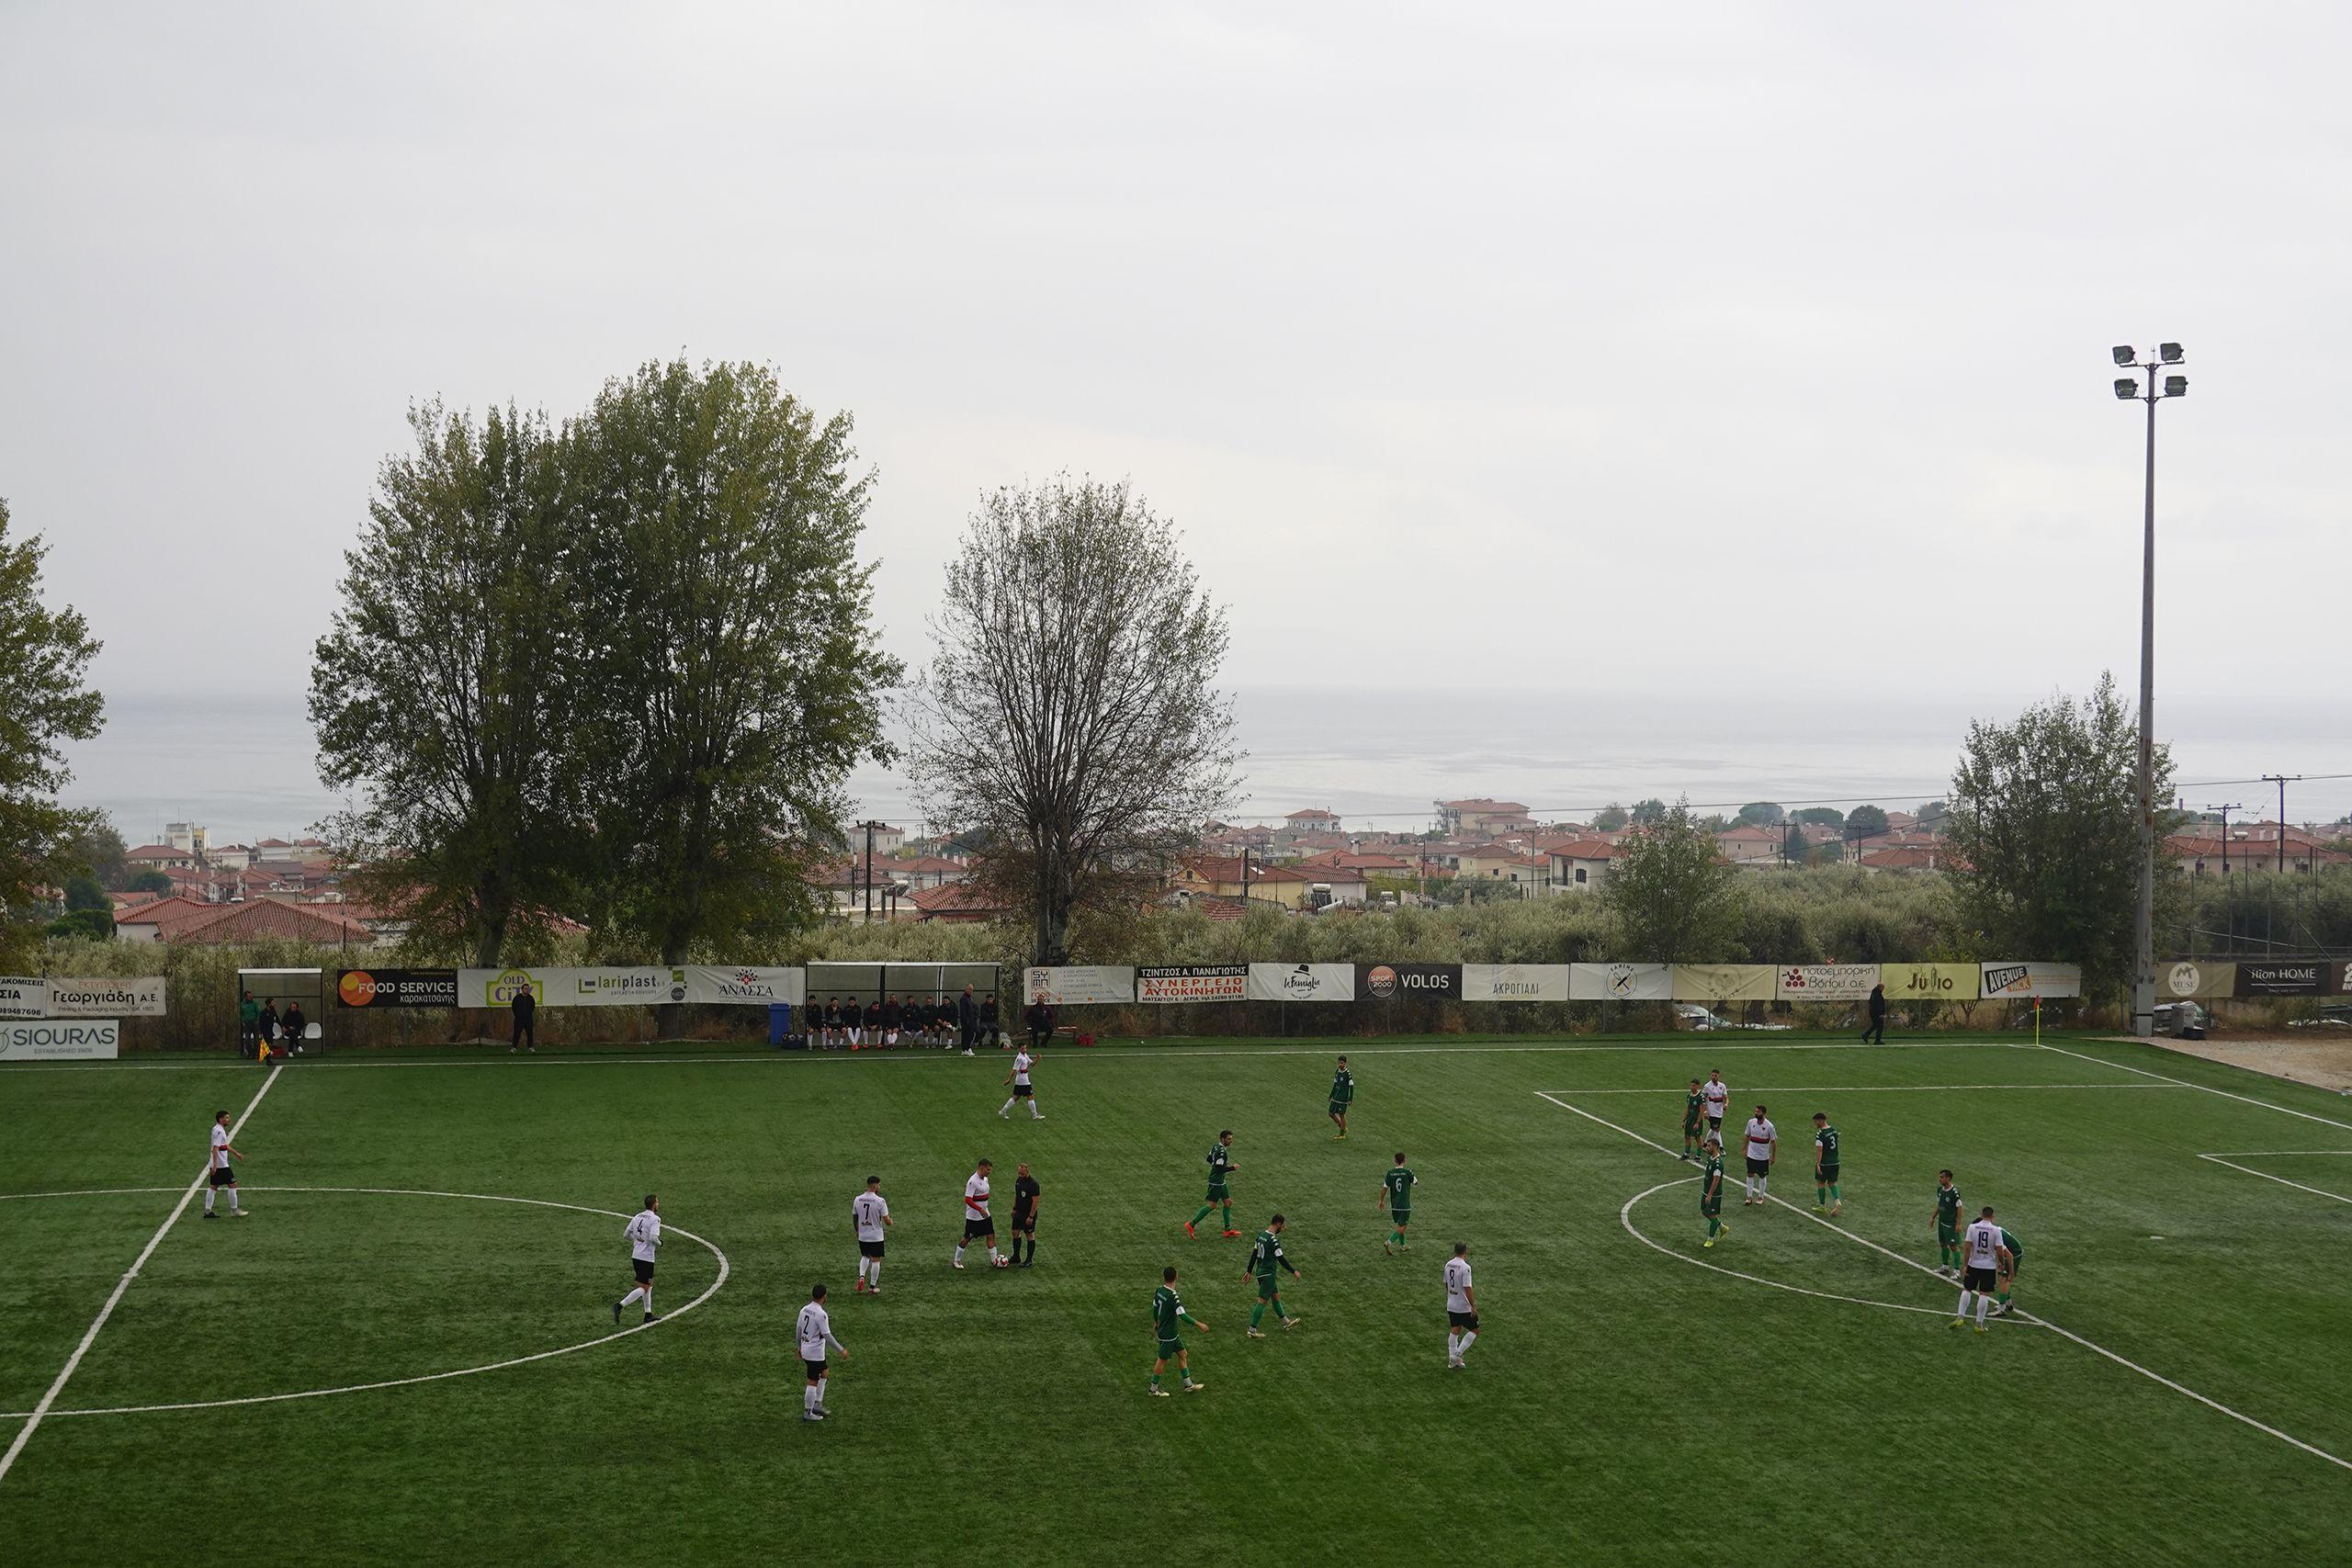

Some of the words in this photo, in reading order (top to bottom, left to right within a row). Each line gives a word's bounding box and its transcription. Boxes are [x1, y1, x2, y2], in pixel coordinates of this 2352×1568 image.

[1141, 967, 1181, 977] ΤΖΙΝΤΖΟΣ
[1193, 966, 1247, 976] ΠΑΝΑΓΙΩΤΗΣ
[1803, 965, 1875, 976] ποτοεμπορική
[2279, 968, 2316, 979] HOME
[0, 977, 44, 987] ΑΚΟΜΙΣΕΙΣ
[503, 976, 526, 985] OLD
[598, 975, 657, 990] lariplast
[1145, 977, 1242, 987] ΣΥΝΕΡΓΕΙΟ
[1401, 974, 1449, 988] VOLOS
[1988, 966, 2025, 992] AVENUE
[358, 982, 395, 994] FOOD
[400, 982, 456, 994] SERVICE
[1145, 987, 1242, 996] ΑΥΤΟΚΙΝΗΤΩΝ
[1493, 983, 1539, 995] ΑΚΡΟΓΙΑΛΙ
[52, 989, 135, 1005] Γεωργιάδη
[400, 994, 456, 1004] καρακατσάνης
[13, 1028, 116, 1045] SIOURAS
[1830, 1135, 1837, 1149] 3
[1395, 1178, 1402, 1192] 6
[864, 1203, 870, 1220] 7
[637, 1219, 643, 1236] 4
[1978, 1231, 1989, 1248] 19
[1449, 1269, 1455, 1288] 8
[803, 1315, 810, 1336] 2
